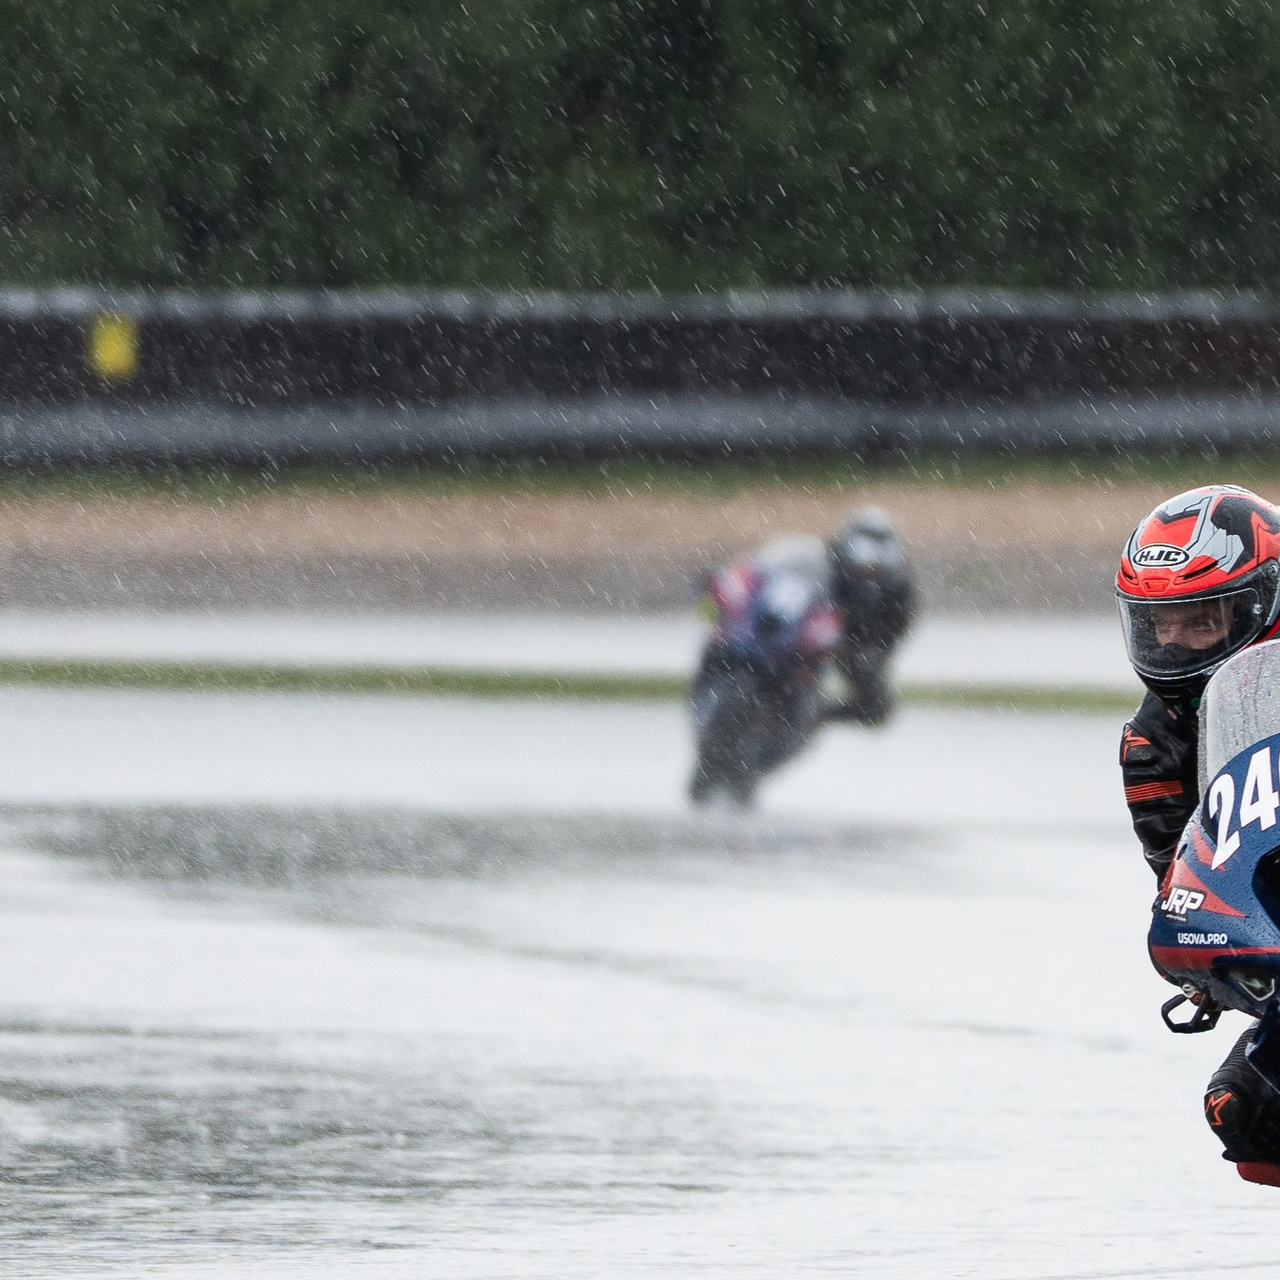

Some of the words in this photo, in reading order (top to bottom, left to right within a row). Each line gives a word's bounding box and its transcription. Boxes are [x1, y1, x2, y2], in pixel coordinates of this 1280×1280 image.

[1138, 550, 1181, 562] HJC
[1161, 888, 1205, 915] JRP
[1178, 932, 1228, 945] USOVA.PRO
